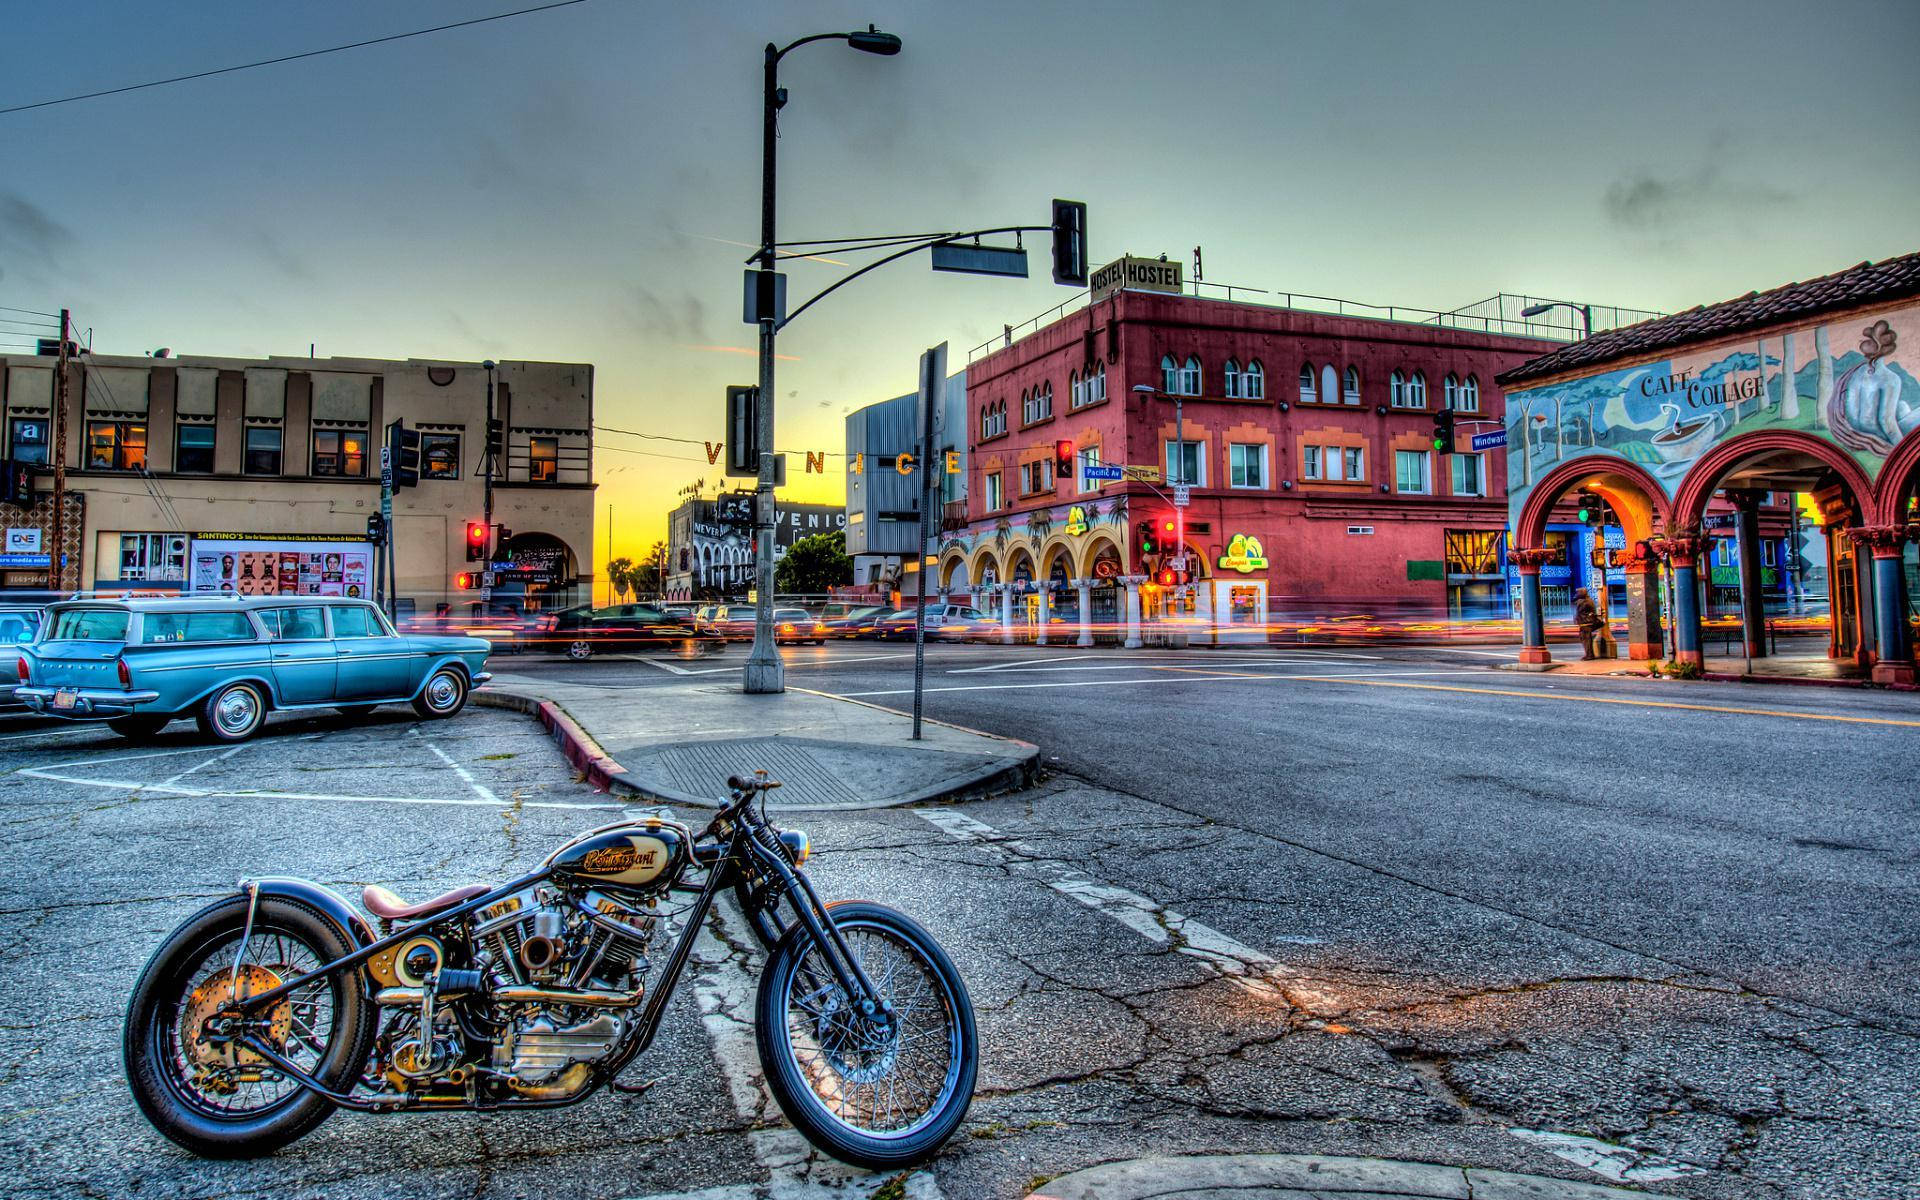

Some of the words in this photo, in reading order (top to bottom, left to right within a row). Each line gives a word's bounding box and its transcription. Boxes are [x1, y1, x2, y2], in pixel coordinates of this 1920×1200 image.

[1091, 263, 1121, 292] HOSTEL
[1129, 264, 1180, 286] HOSTEL
[1641, 366, 1693, 397] CAFÉ
[1688, 376, 1764, 408] COLLAGE
[704, 441, 961, 476] VNICE
[1087, 468, 1110, 476] Pacific
[1111, 468, 1119, 477] Av
[694, 522, 719, 537] NEVER
[776, 511, 846, 528] VENIC
[197, 532, 244, 540] SANTINO'S
